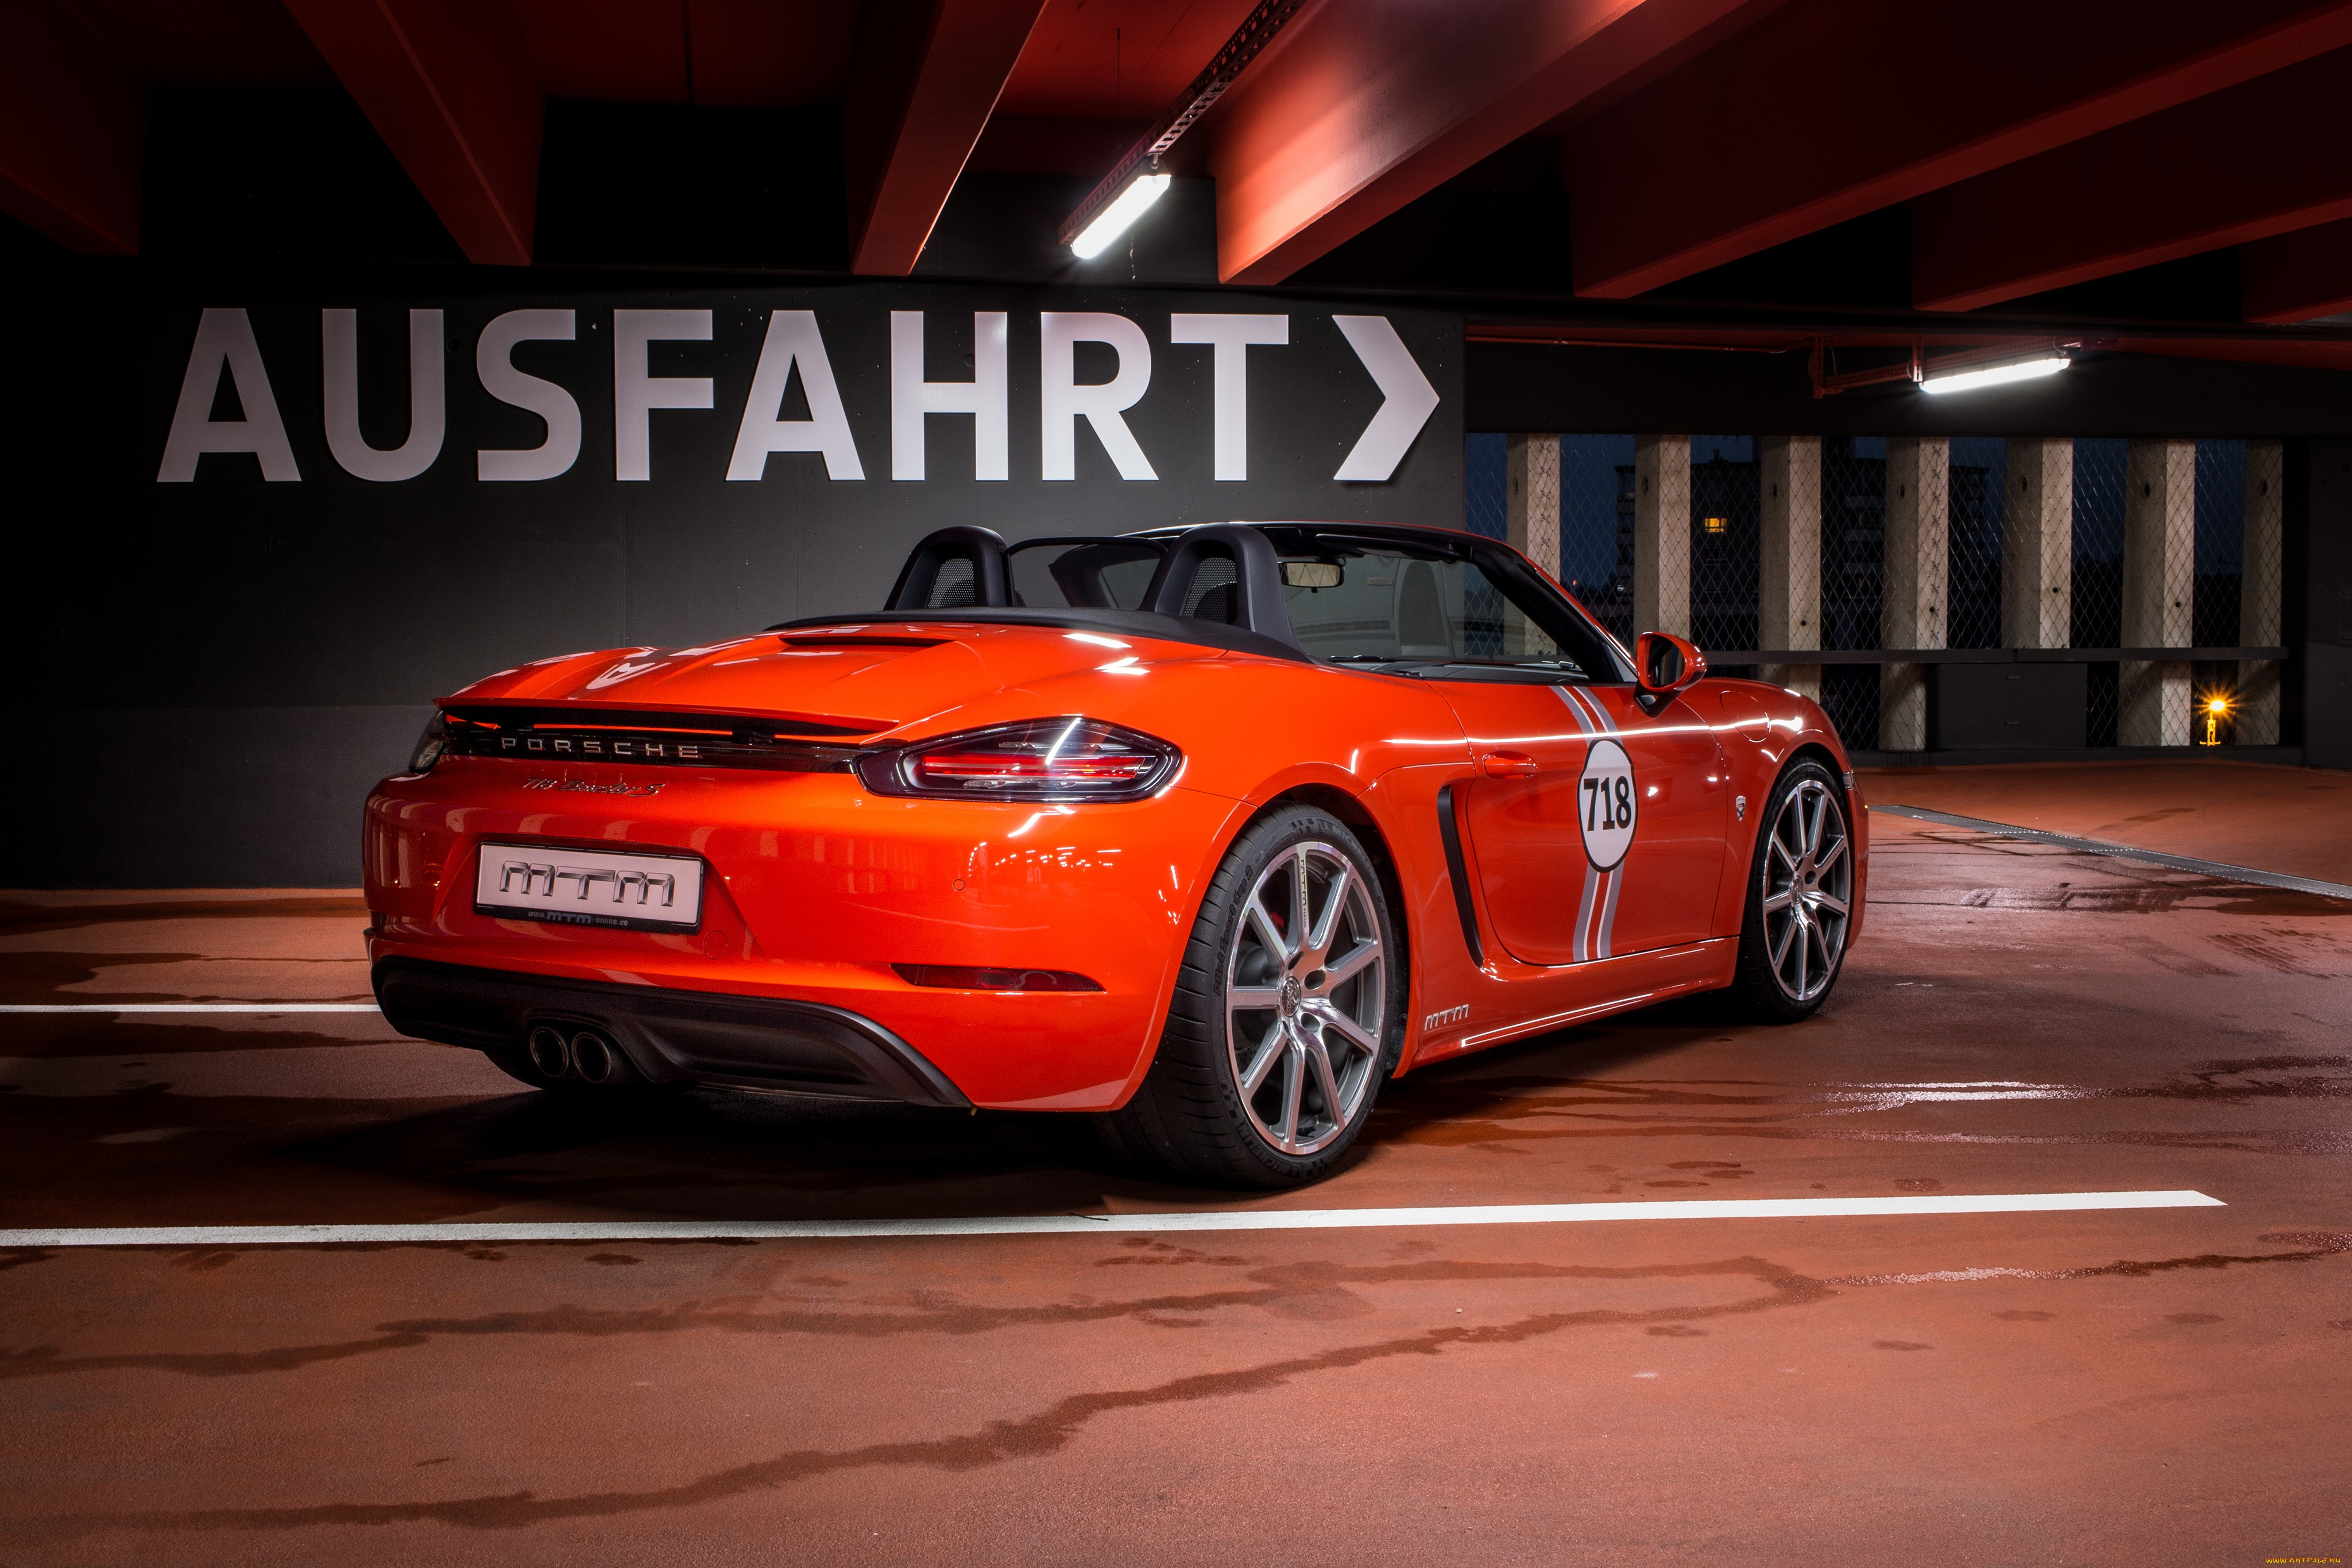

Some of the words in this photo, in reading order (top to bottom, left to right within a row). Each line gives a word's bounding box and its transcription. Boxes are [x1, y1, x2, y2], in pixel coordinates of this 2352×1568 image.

[157, 307, 1290, 482] AUSFAHRT
[501, 737, 700, 758] PORSCHE
[522, 777, 558, 789] 718
[628, 784, 665, 797] S
[1583, 775, 1632, 832] 718
[1232, 878, 1248, 905] Cup
[1244, 865, 1254, 881] 2
